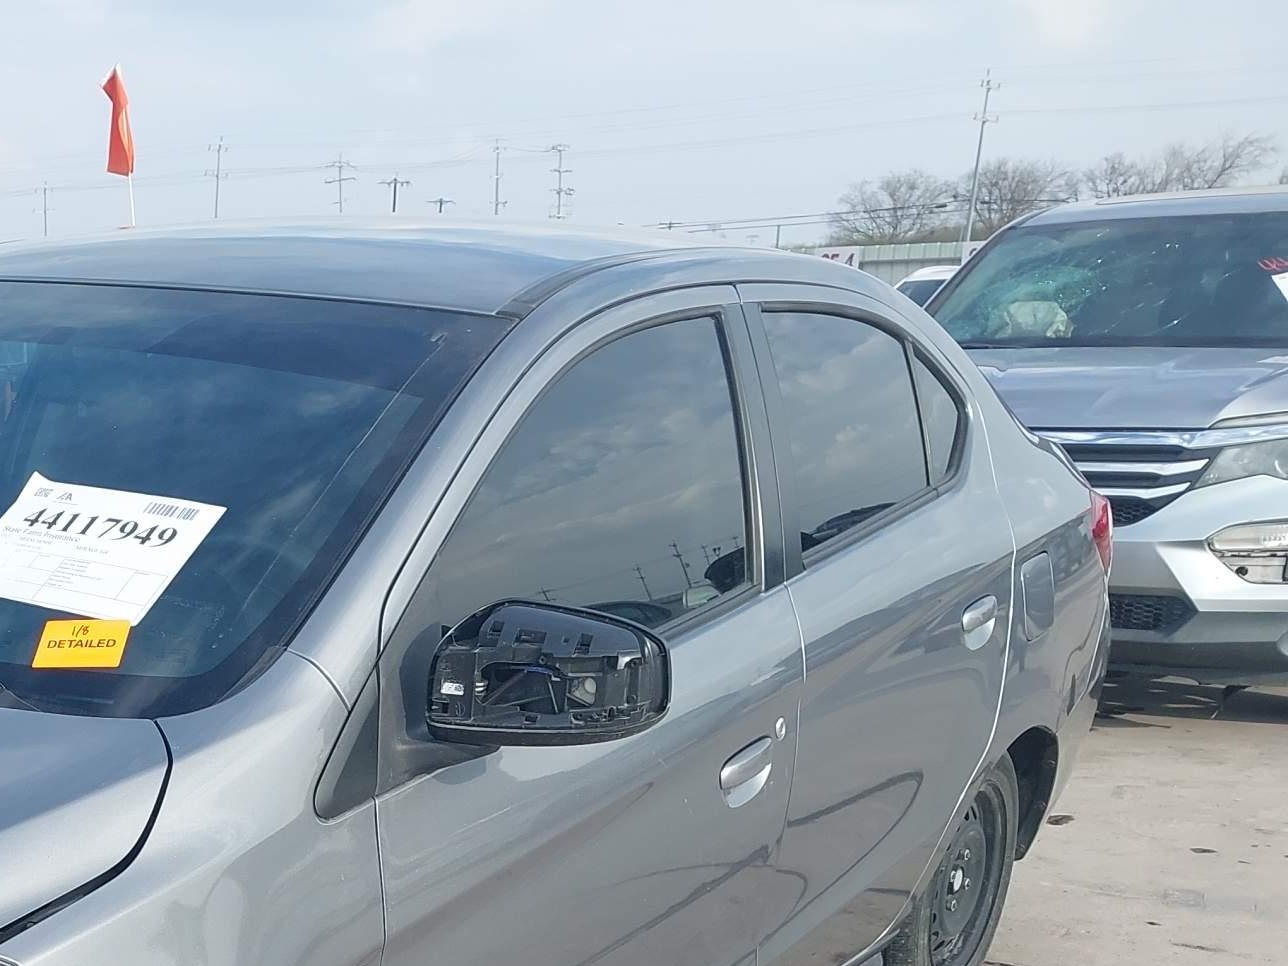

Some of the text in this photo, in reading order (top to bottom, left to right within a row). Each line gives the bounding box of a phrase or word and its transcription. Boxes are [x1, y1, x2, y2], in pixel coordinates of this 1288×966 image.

[23, 507, 179, 548] 44117949
[71, 624, 90, 638] 1/8
[47, 638, 117, 649] DETAILED
